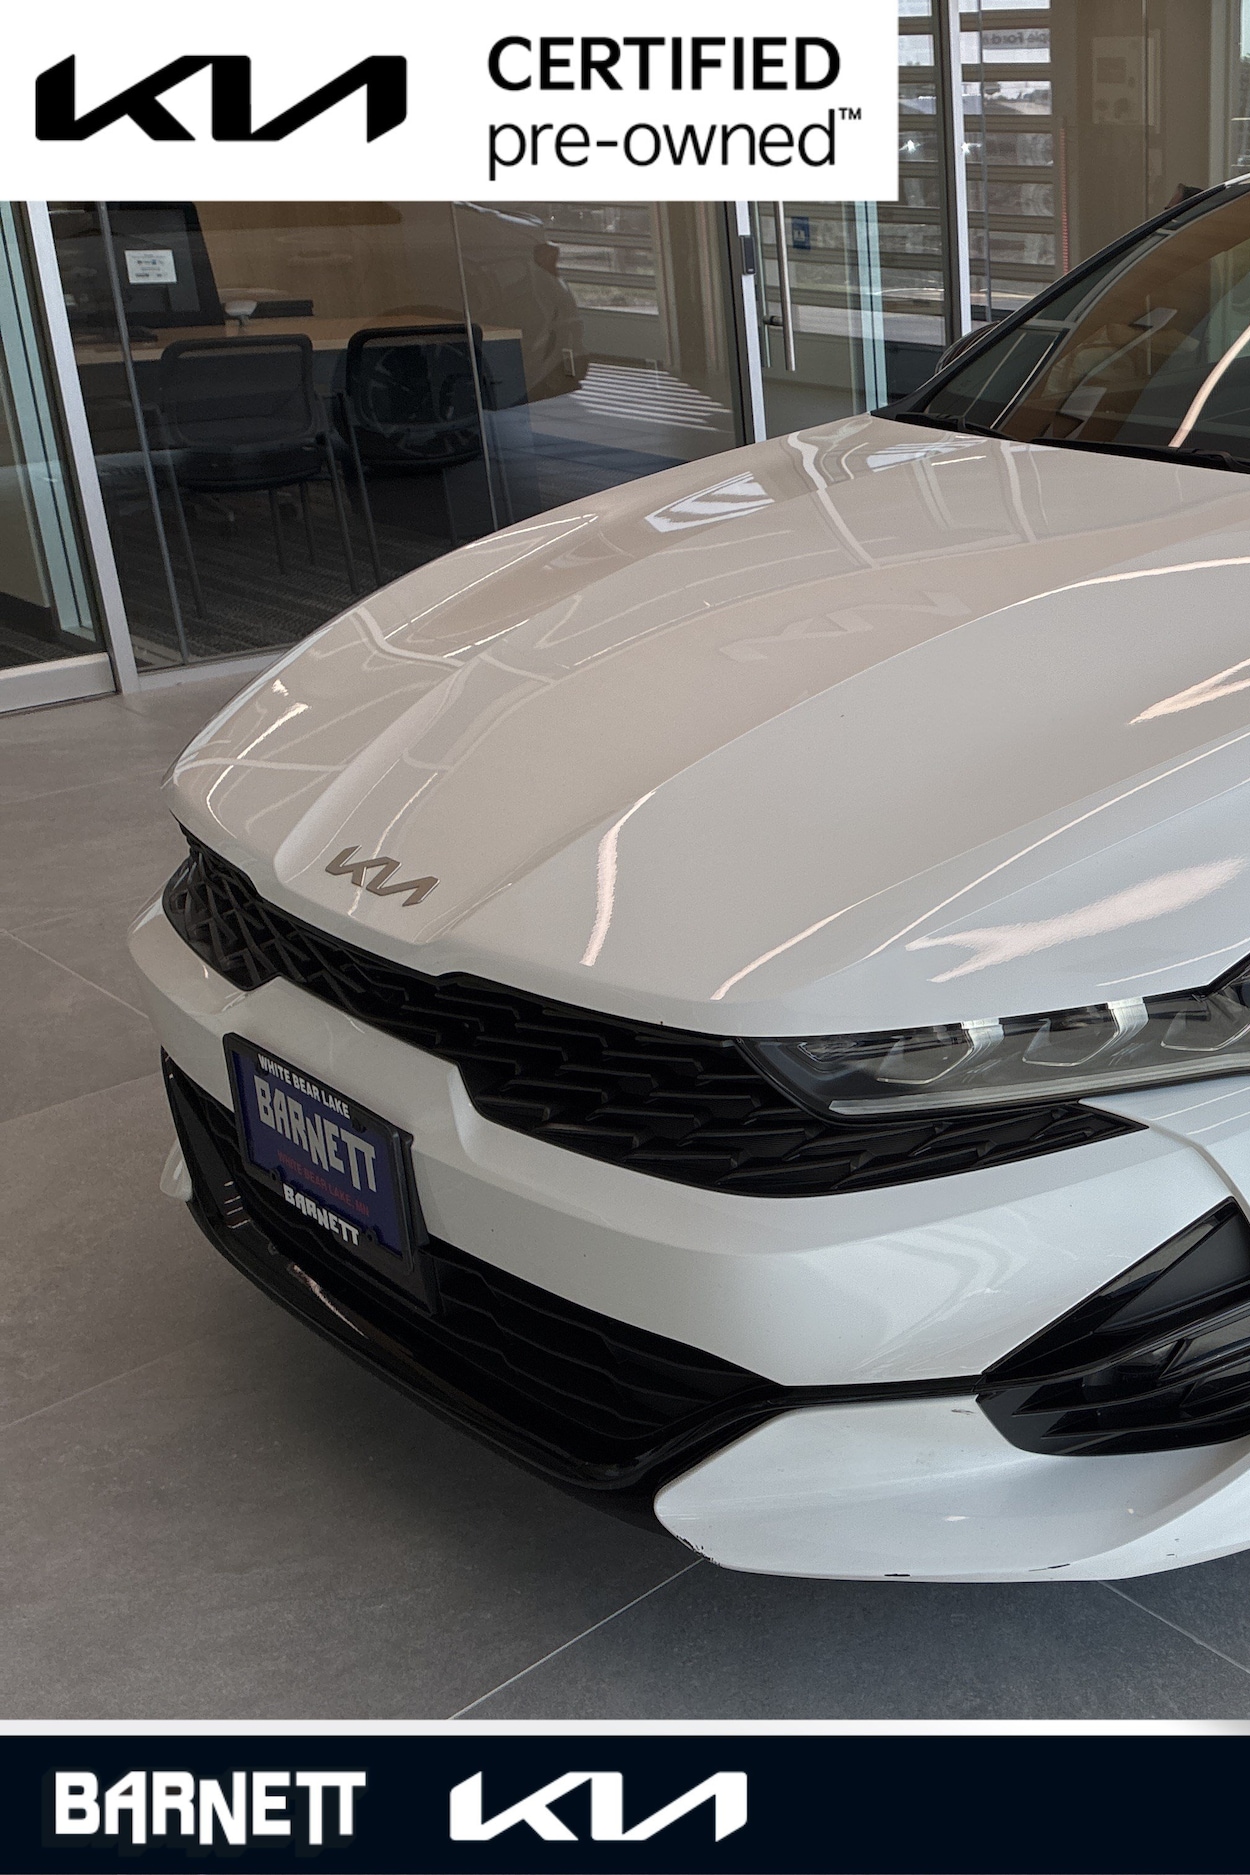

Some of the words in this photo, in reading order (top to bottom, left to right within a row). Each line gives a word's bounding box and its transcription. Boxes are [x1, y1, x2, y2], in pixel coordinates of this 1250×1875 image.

[325, 845, 440, 907] KIA
[258, 1053, 292, 1085] WHITE
[292, 1073, 320, 1102] BEAR
[321, 1089, 350, 1120] LAKE
[253, 1074, 377, 1193] BARNETT
[277, 1150, 303, 1176] WHITE
[303, 1167, 328, 1191] BEAR
[282, 1183, 360, 1246] BARNETT
